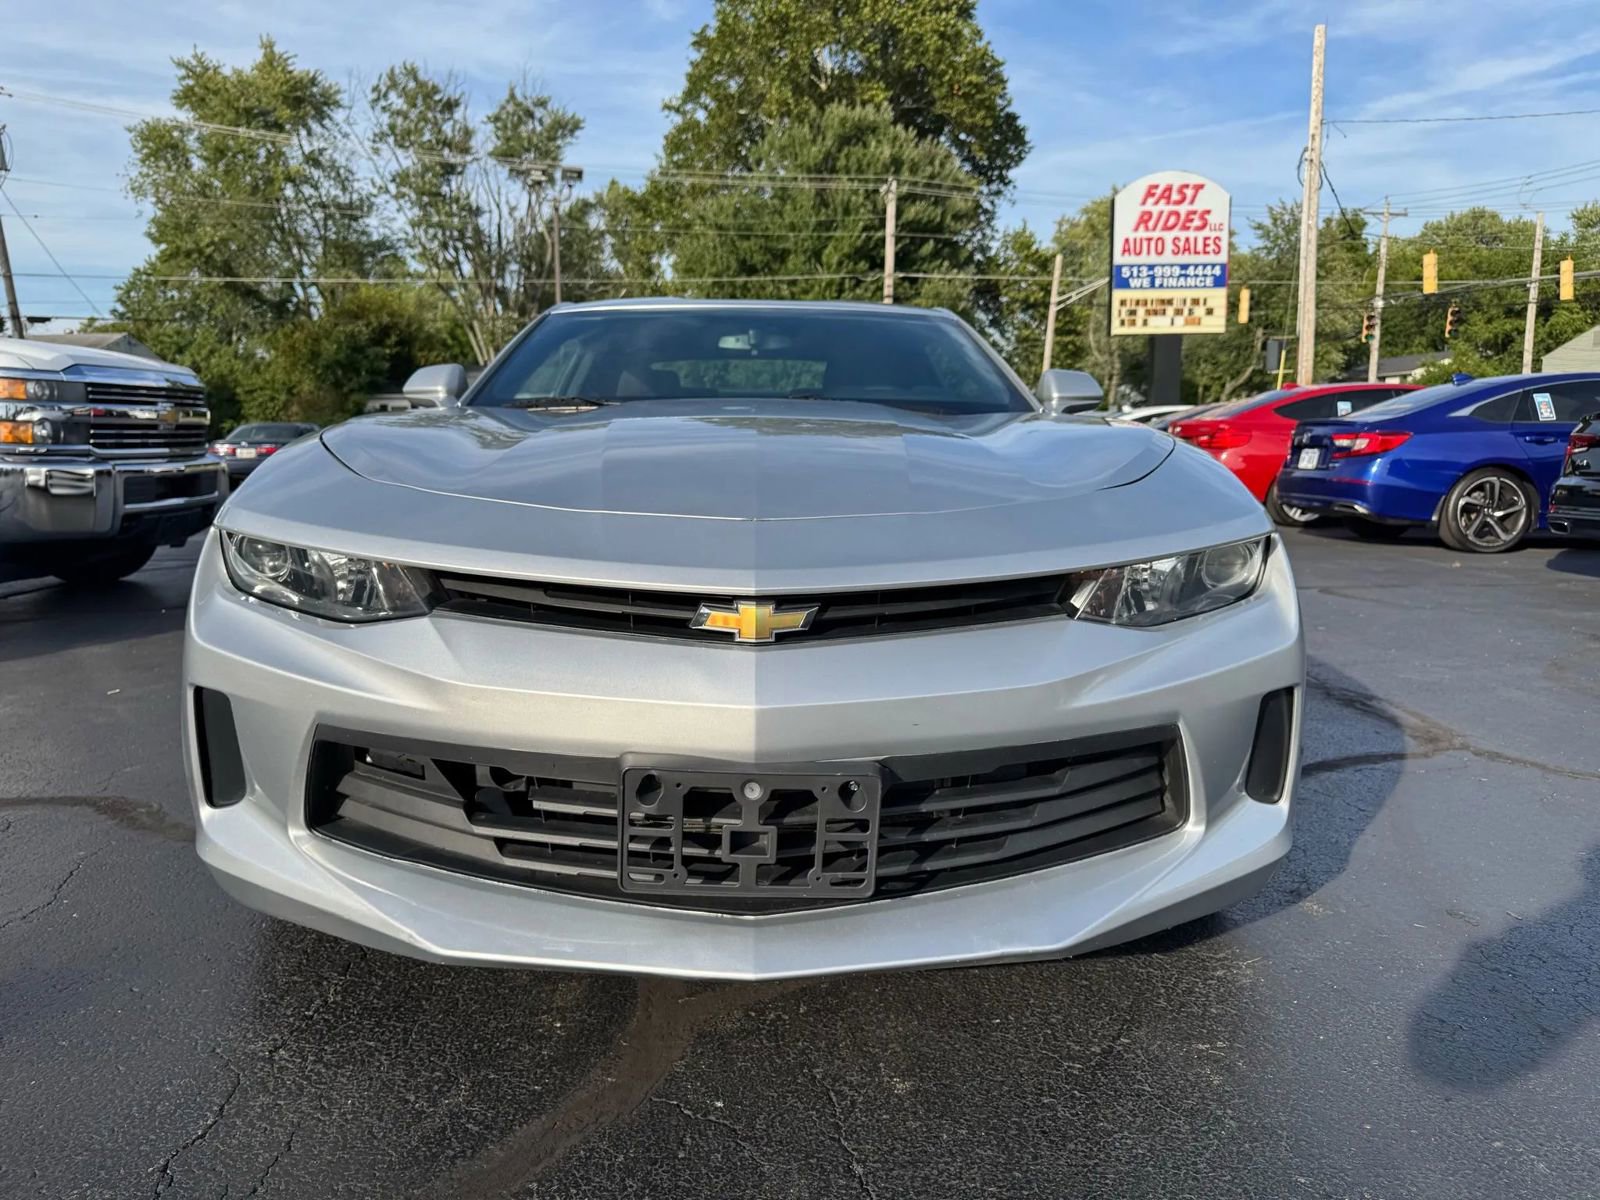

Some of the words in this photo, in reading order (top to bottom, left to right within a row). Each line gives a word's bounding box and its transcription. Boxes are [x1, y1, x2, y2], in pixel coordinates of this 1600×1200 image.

[1141, 184, 1205, 205] FAST
[1133, 210, 1211, 231] RIDES
[1209, 223, 1224, 232] LLC
[1121, 237, 1165, 256] AUTO
[1172, 236, 1222, 255] SALES
[1128, 277, 1151, 288] WE
[1155, 276, 1214, 288] FINANCE
